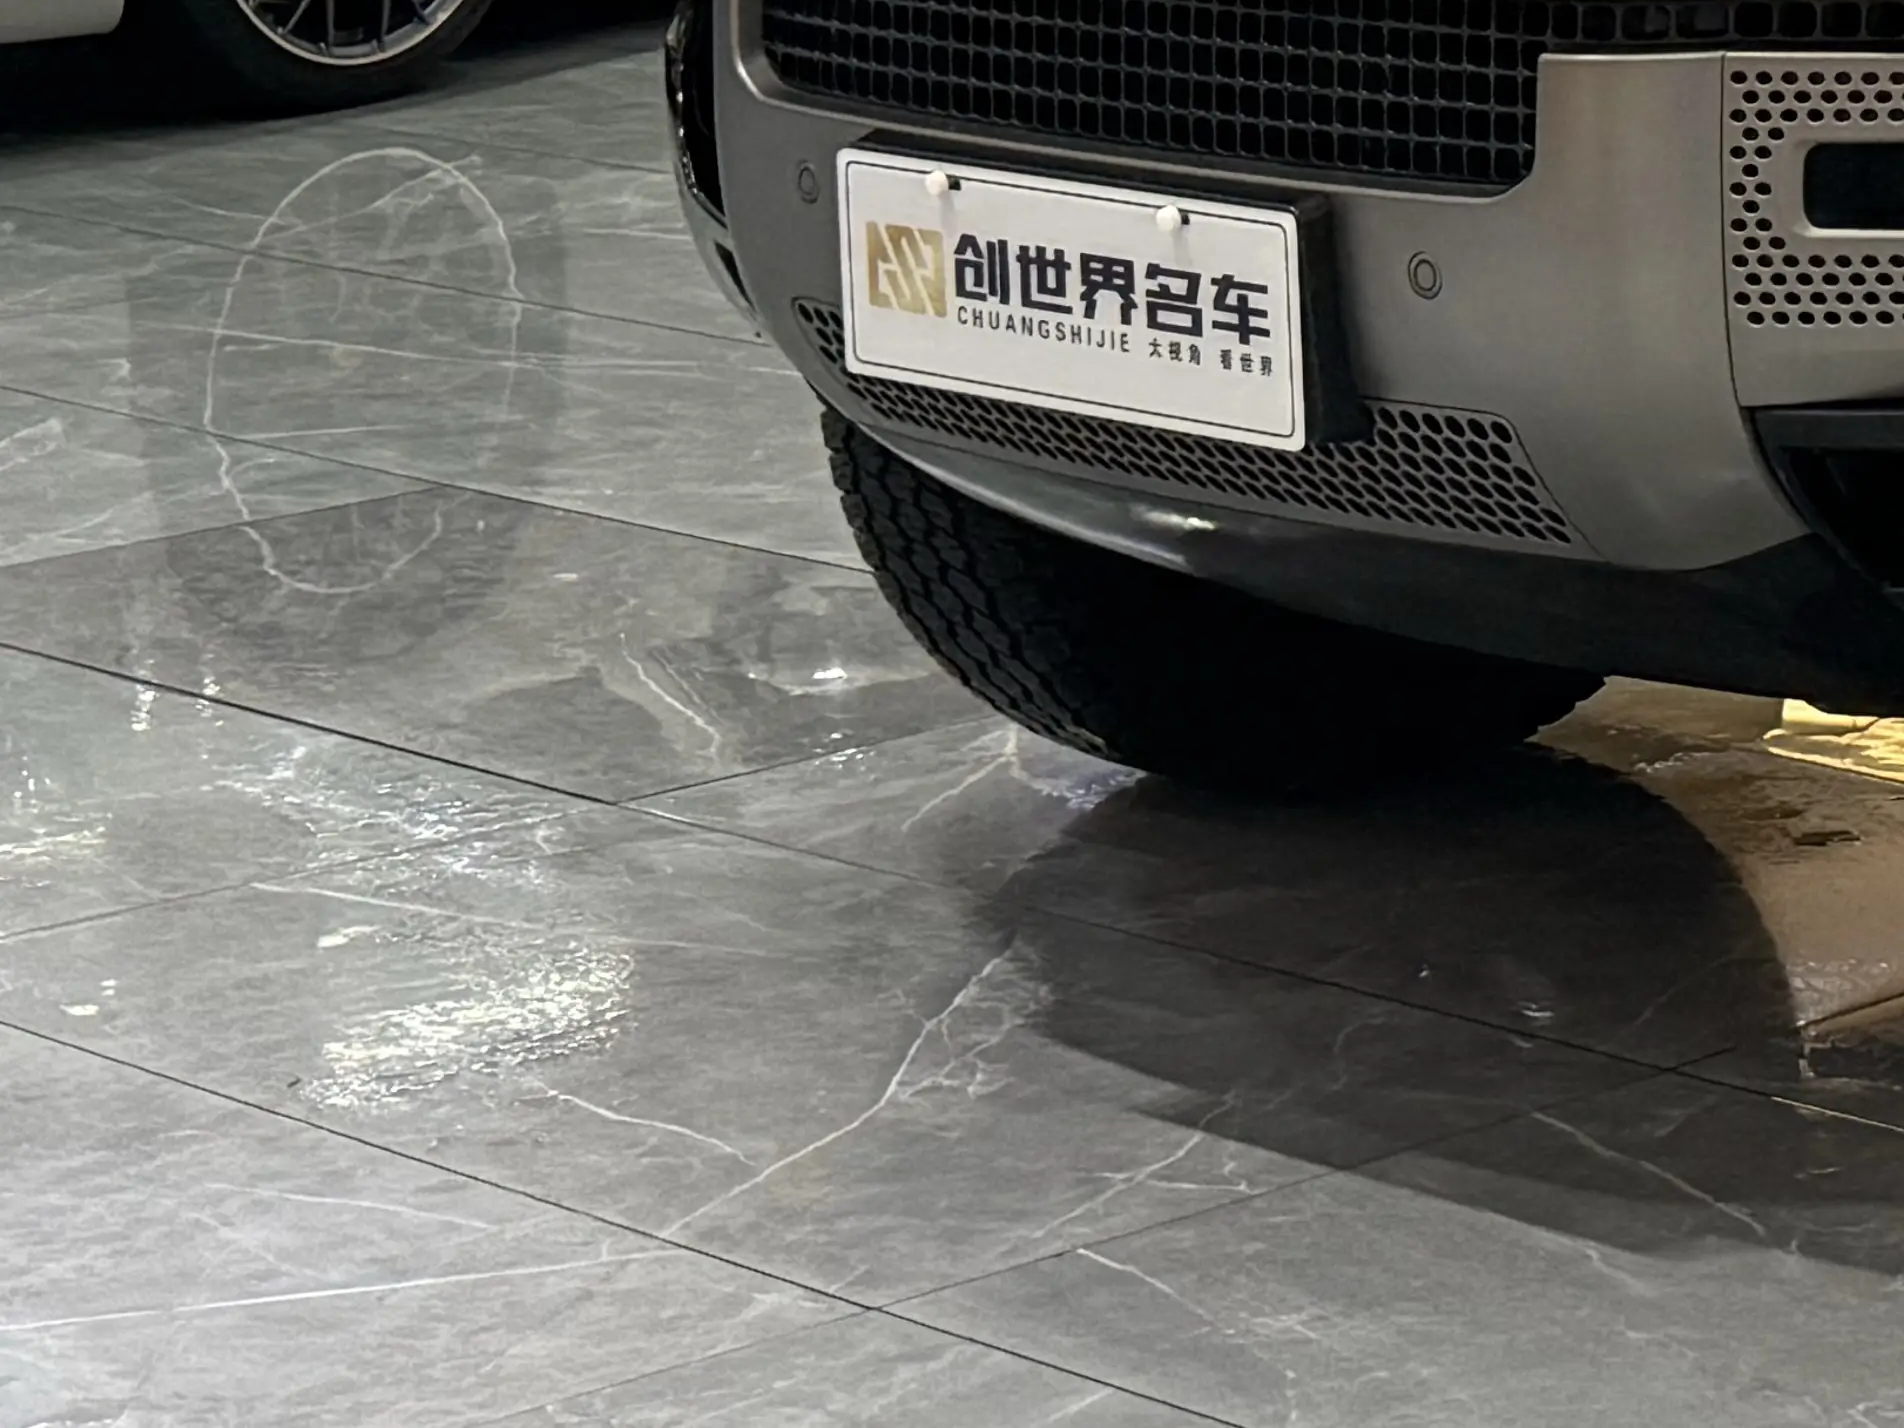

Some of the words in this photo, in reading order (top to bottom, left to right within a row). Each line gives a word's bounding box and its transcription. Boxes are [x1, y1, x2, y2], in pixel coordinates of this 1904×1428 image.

[953, 232, 1271, 345] 创世界名车
[957, 306, 1130, 353] CHUANGSHIJIE
[1147, 337, 1201, 366] 大视角
[1220, 349, 1272, 376] 看世界
